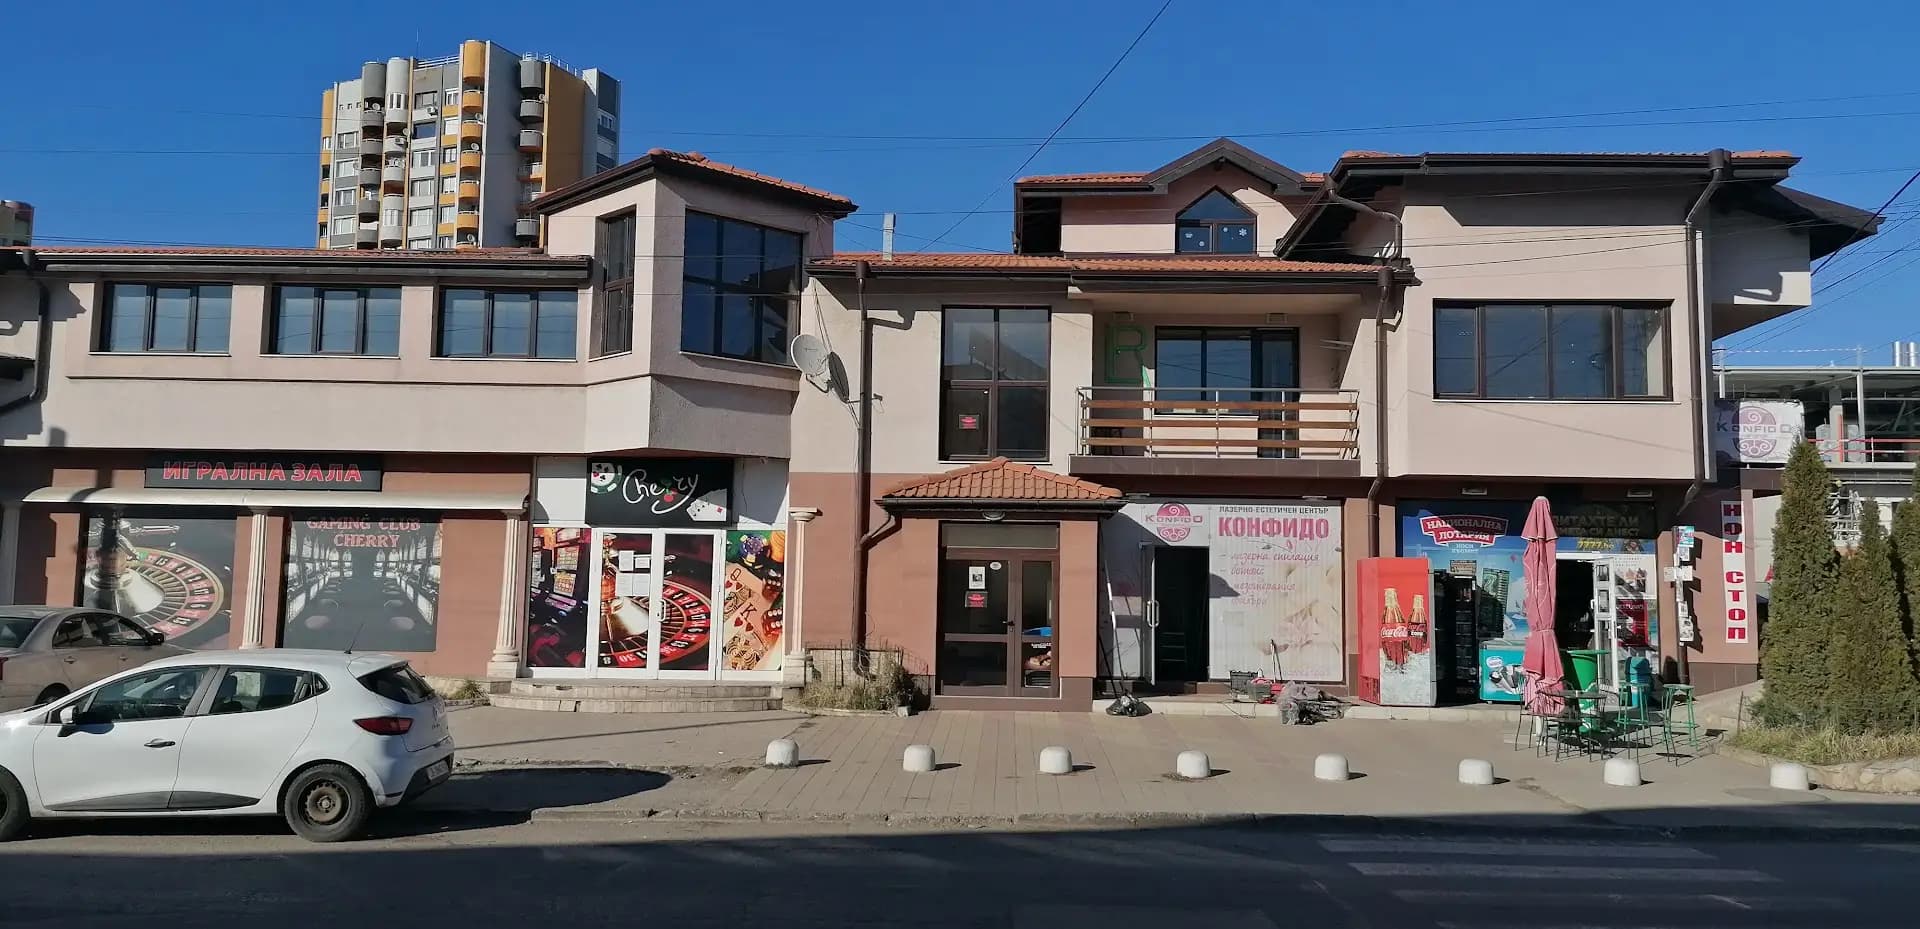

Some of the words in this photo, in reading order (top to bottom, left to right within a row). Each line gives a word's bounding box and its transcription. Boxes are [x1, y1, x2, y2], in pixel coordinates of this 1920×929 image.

[1716, 422, 1792, 433] KONFIDO
[163, 461, 286, 481] ИГРАЛНА
[291, 463, 362, 482] ЗАЛА
[1299, 507, 1328, 515] ЦЕНТЪР
[305, 517, 370, 530] GAMING
[378, 518, 421, 531] CLUB
[1145, 514, 1203, 523] KONFIDO
[1426, 518, 1504, 531] НАЦИОНАЛНА
[1218, 517, 1329, 540] КОНФИДО
[334, 534, 400, 548] CHERRY
[1439, 531, 1490, 541] ЛОТАРИЯ
